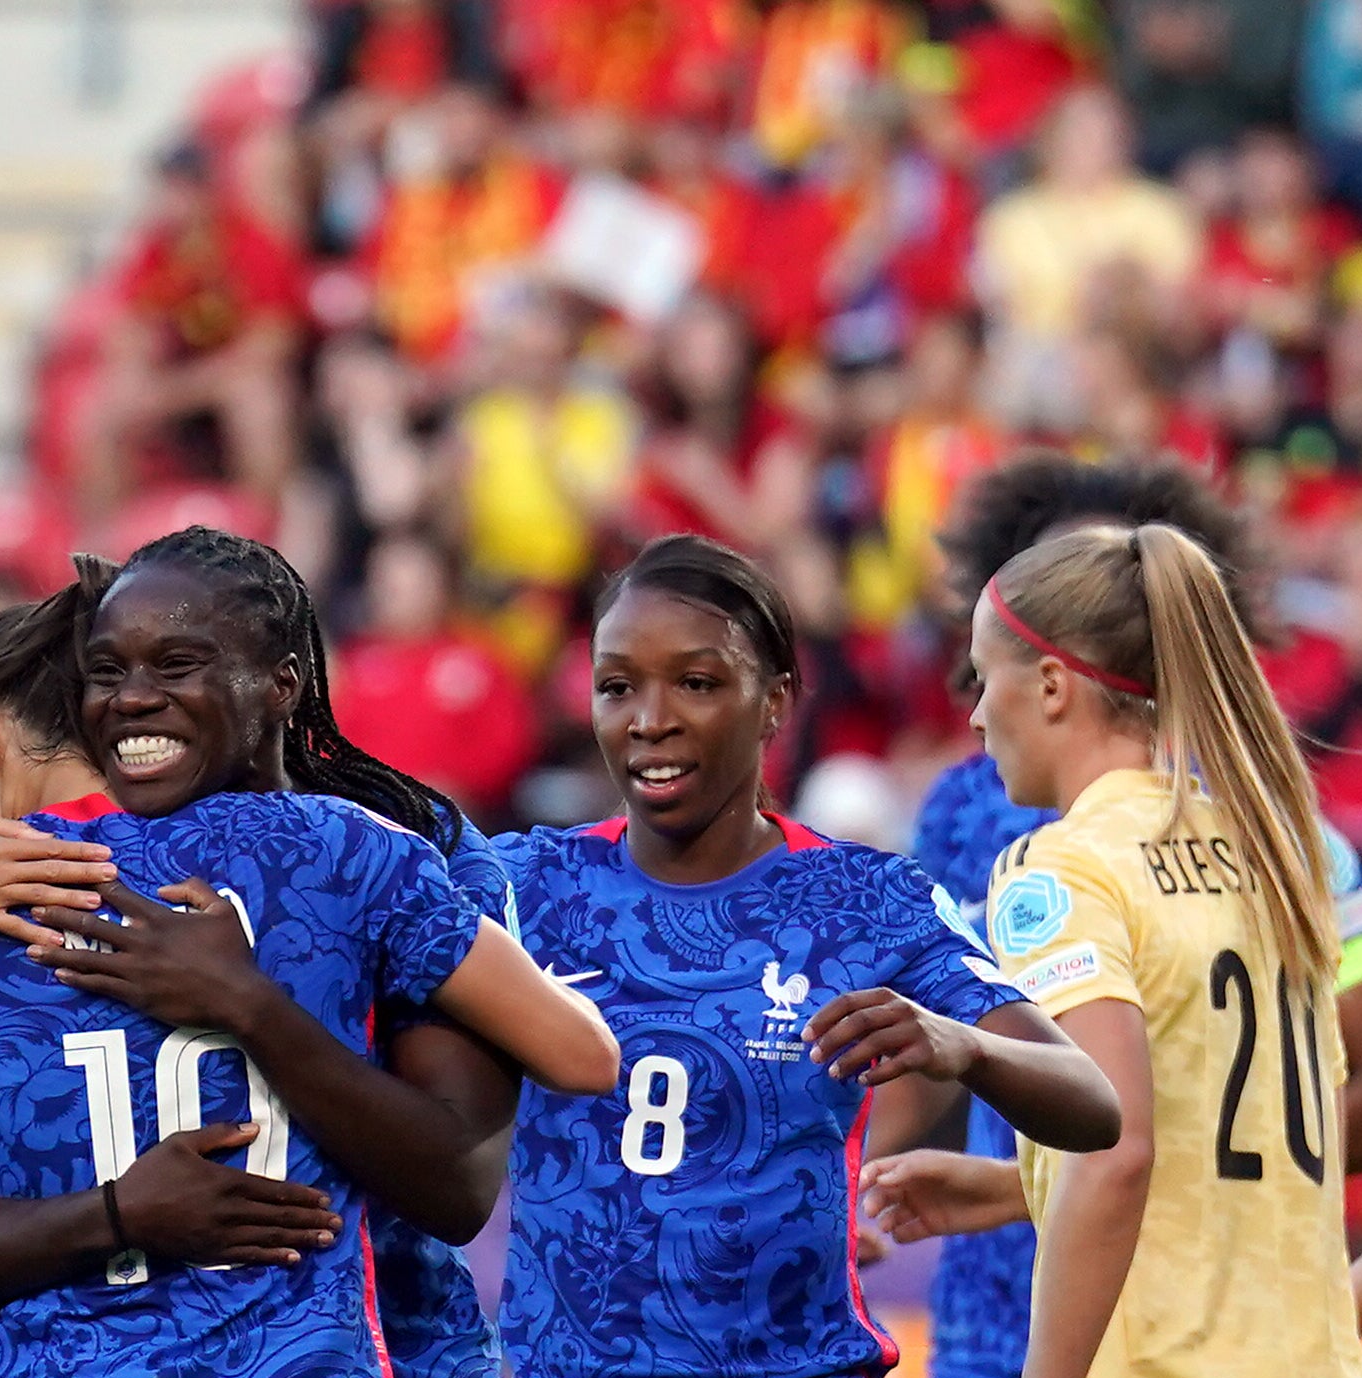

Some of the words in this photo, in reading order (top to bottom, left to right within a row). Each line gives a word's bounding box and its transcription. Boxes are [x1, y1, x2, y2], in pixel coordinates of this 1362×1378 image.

[1139, 837, 1257, 895] BIES
[62, 1024, 290, 1285] 10
[620, 1055, 688, 1177] 8
[1209, 948, 1325, 1186] 20
